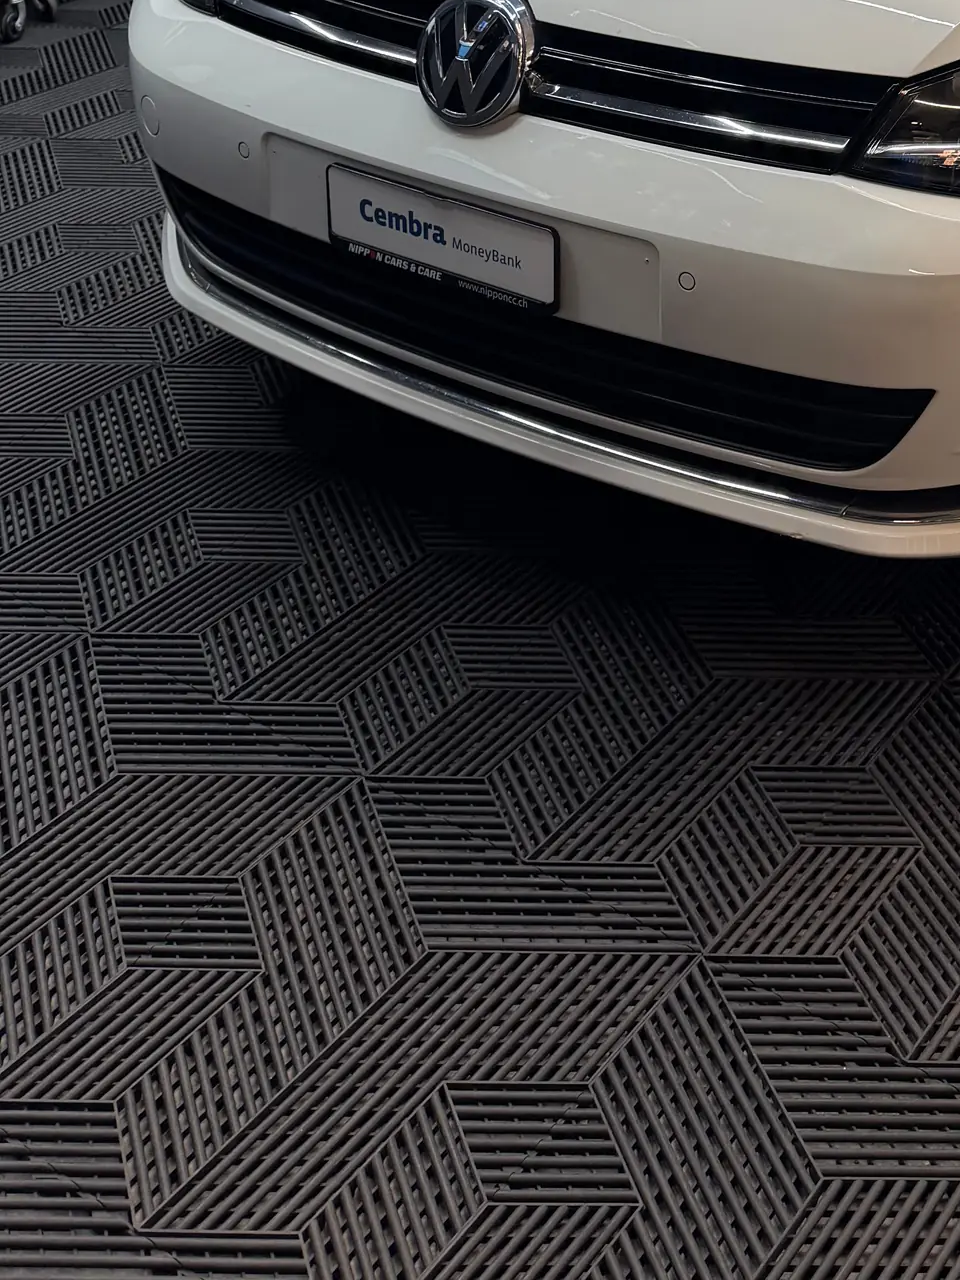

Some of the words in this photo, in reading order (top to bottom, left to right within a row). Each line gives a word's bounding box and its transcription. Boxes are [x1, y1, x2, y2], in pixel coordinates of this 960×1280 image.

[360, 198, 447, 246] Cembra
[452, 237, 522, 270] MoneyBank
[348, 243, 383, 262] NIPPON
[384, 254, 409, 270] CARS
[410, 263, 416, 273] &
[417, 265, 442, 281] CARE
[458, 279, 528, 308] www.nipponcc.ch
